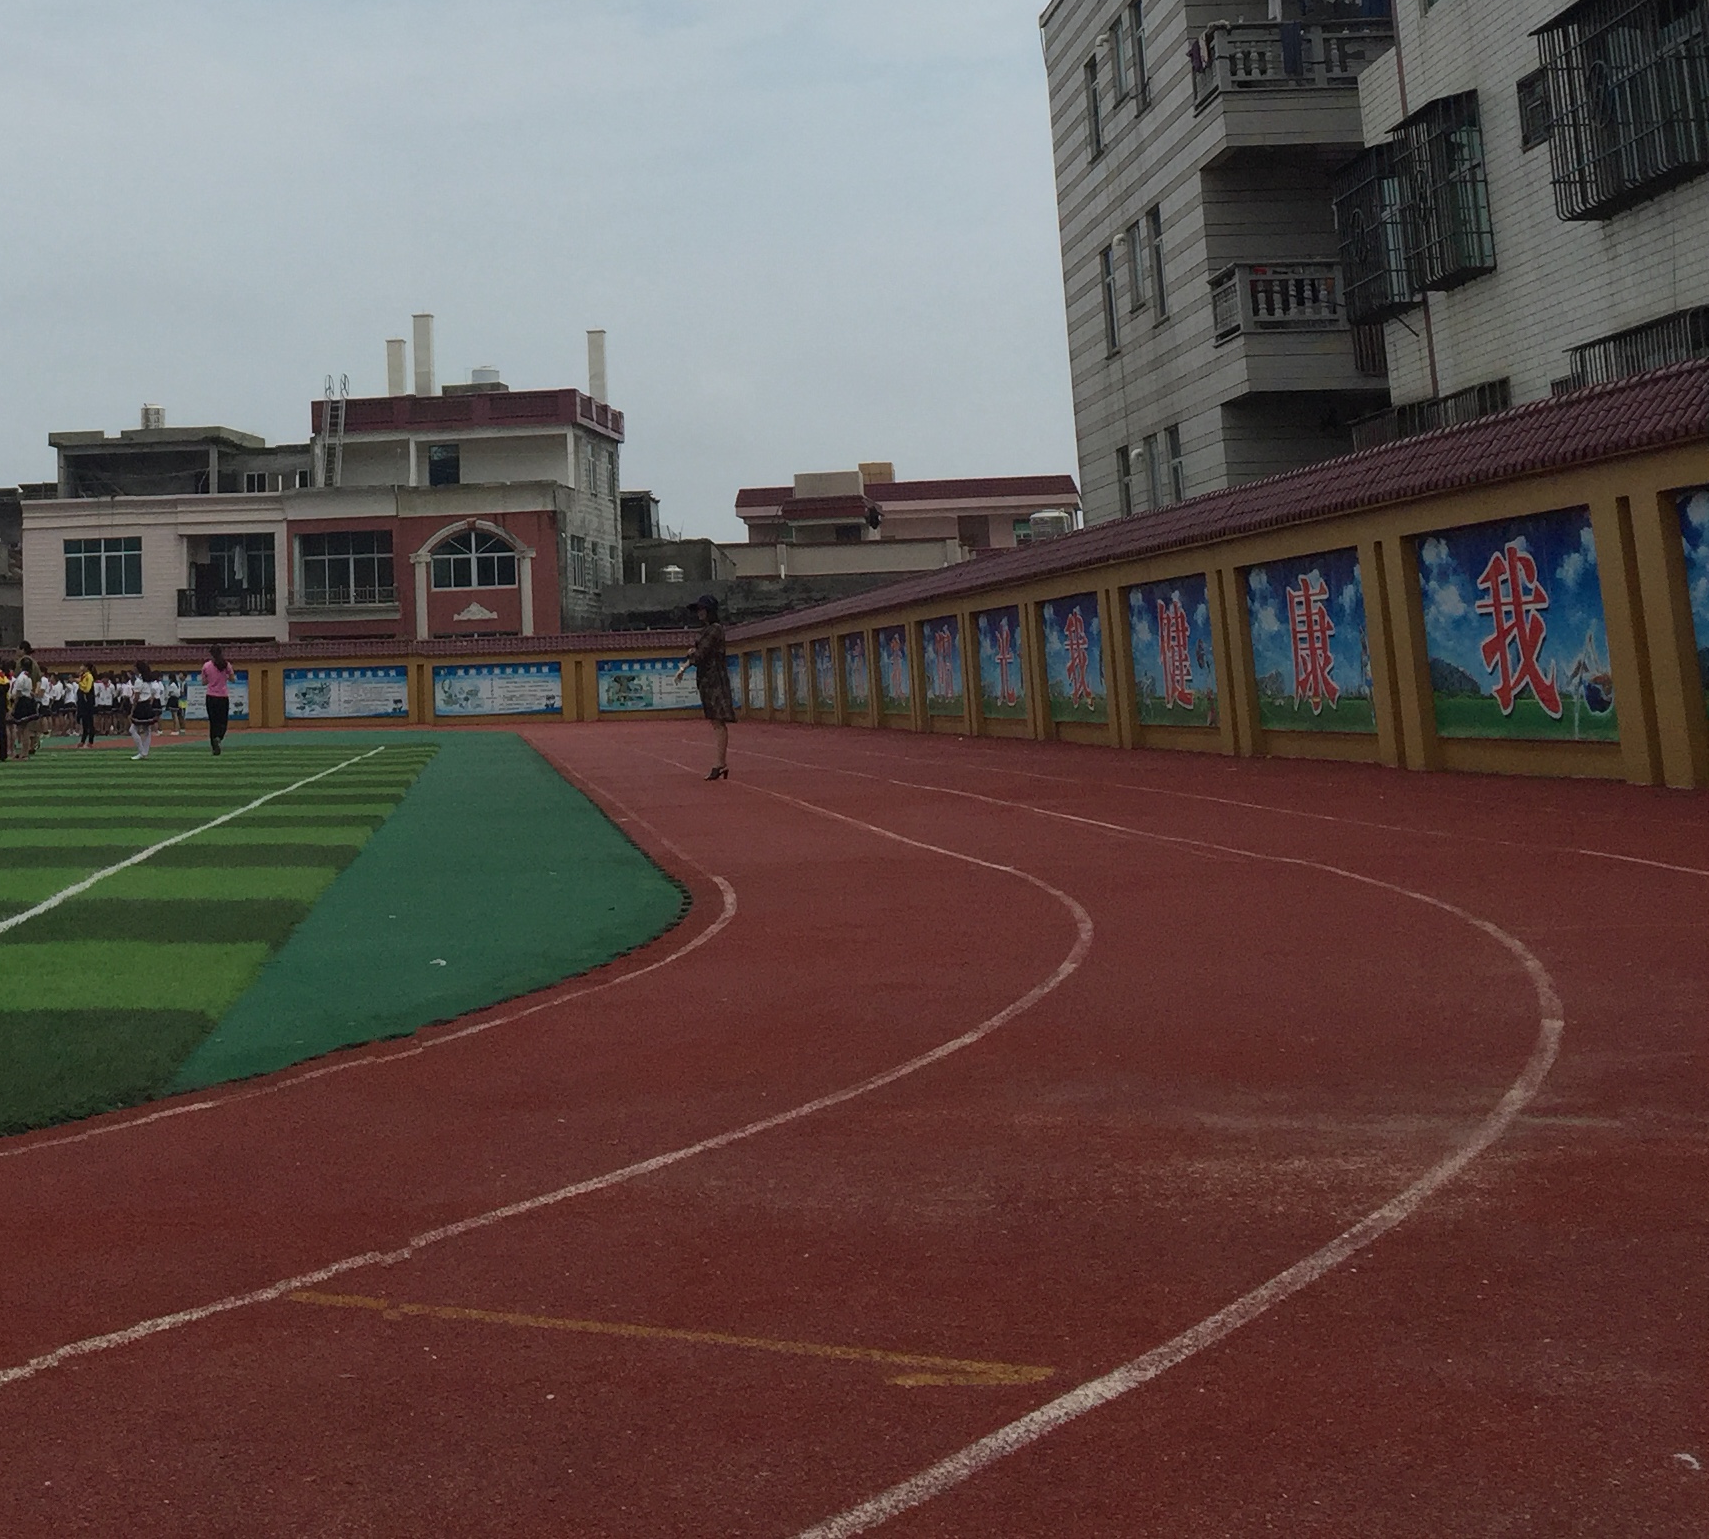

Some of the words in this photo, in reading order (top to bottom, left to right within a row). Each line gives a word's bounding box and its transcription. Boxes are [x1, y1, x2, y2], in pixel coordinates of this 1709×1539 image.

[1157, 597, 1194, 710] 健
[1286, 573, 1340, 715] 康
[1475, 542, 1563, 719] 我
